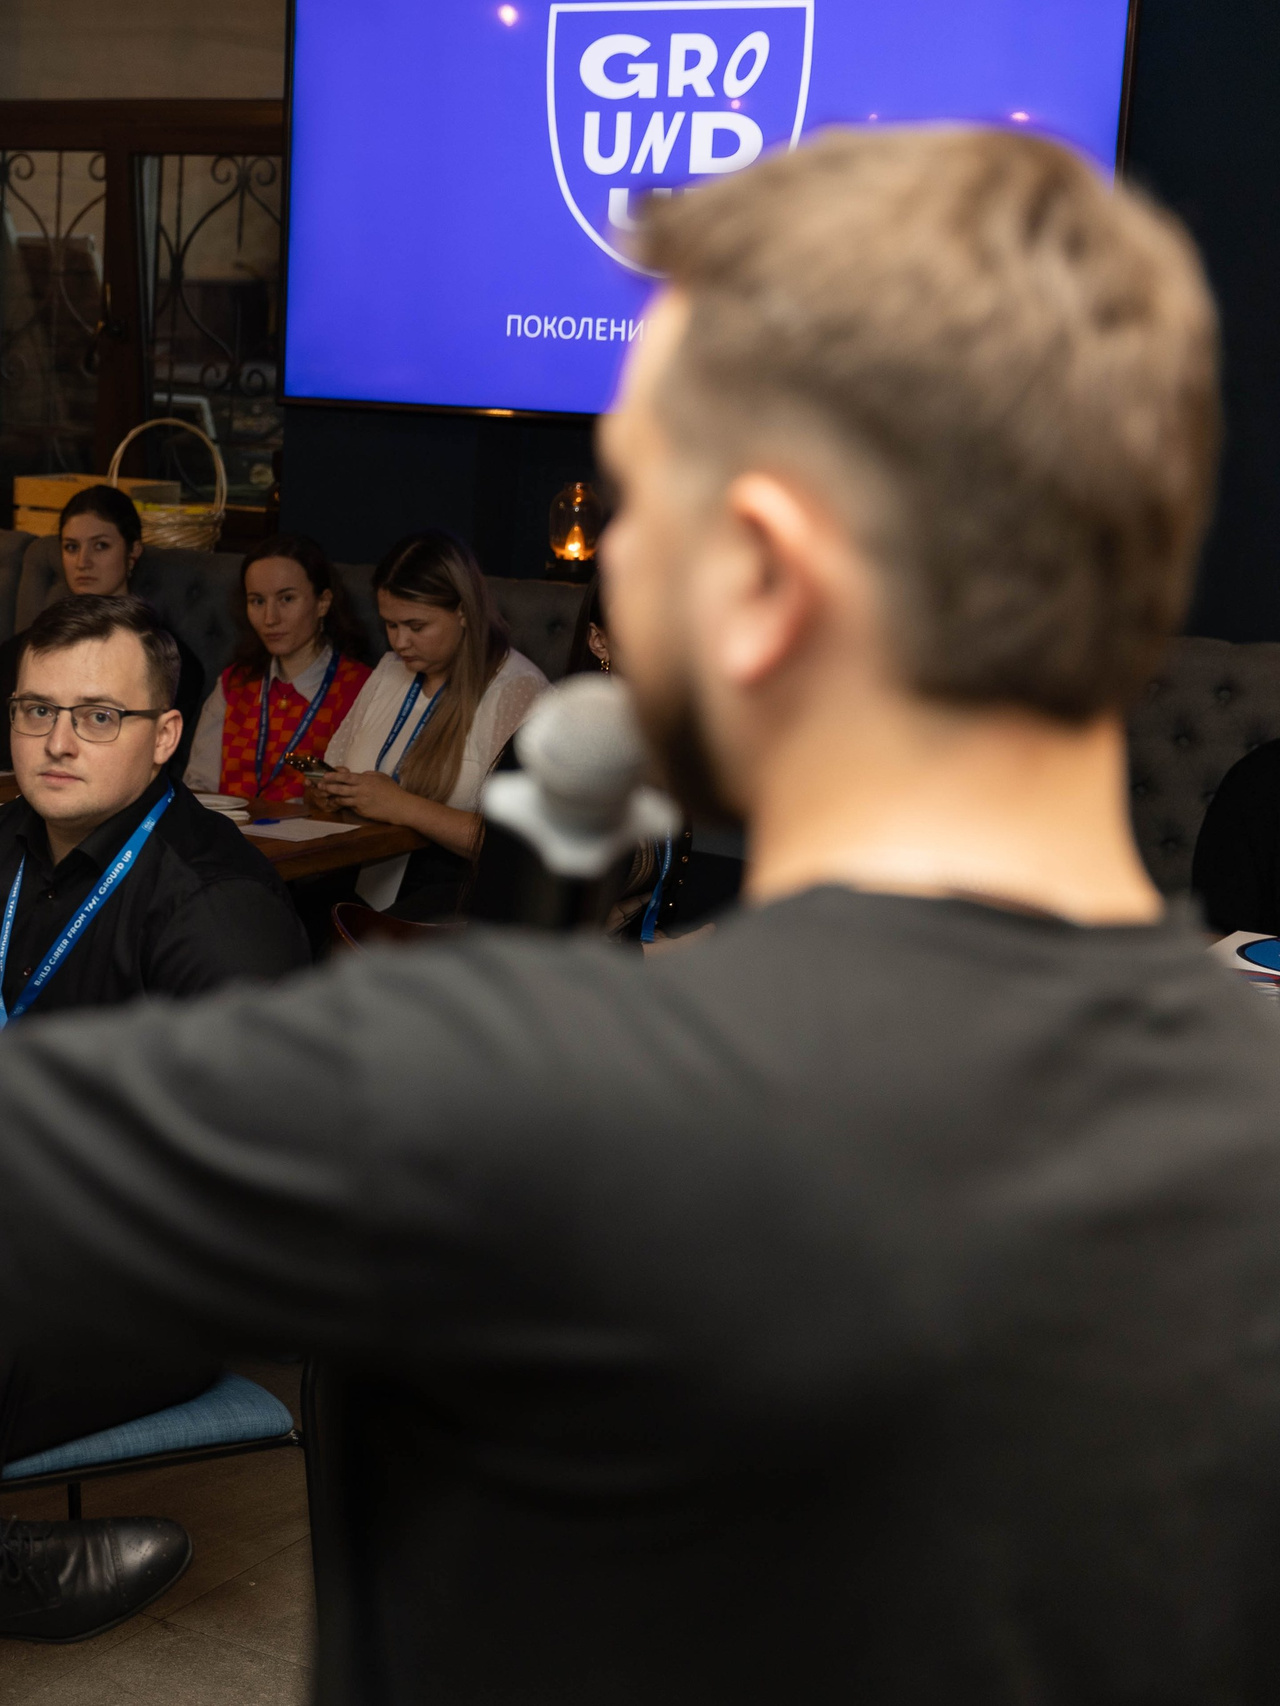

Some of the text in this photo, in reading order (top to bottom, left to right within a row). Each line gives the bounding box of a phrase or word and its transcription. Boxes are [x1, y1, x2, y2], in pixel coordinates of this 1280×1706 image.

[579, 30, 770, 100] GRO
[583, 111, 763, 175] UND
[506, 314, 650, 342] ПОКОЛЕНИ
[34, 850, 133, 987] BUILD CAREER FROM THE GROUND UP
